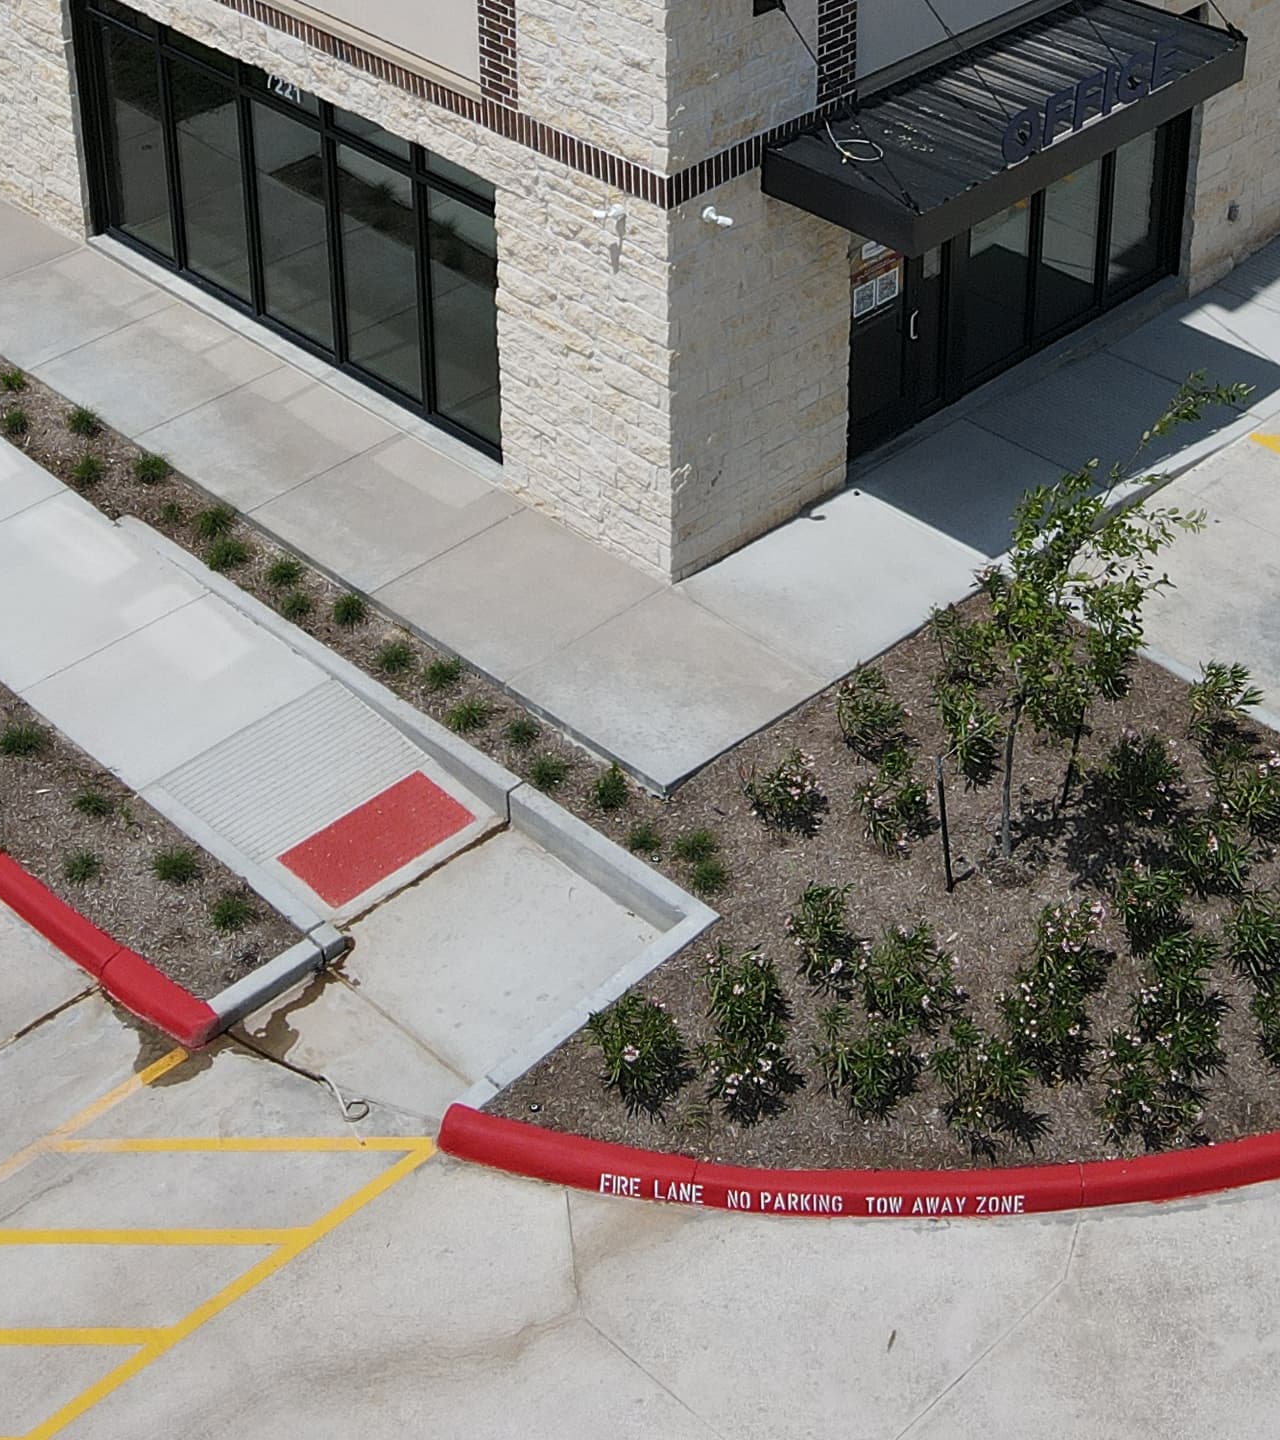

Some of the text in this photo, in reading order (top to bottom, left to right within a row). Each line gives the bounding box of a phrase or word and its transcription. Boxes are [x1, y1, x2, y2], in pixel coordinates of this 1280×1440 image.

[1001, 34, 1184, 169] OFFICE
[600, 1173, 1025, 1214] FIRE LANE NO PARKING TOW AWAY ZONE
